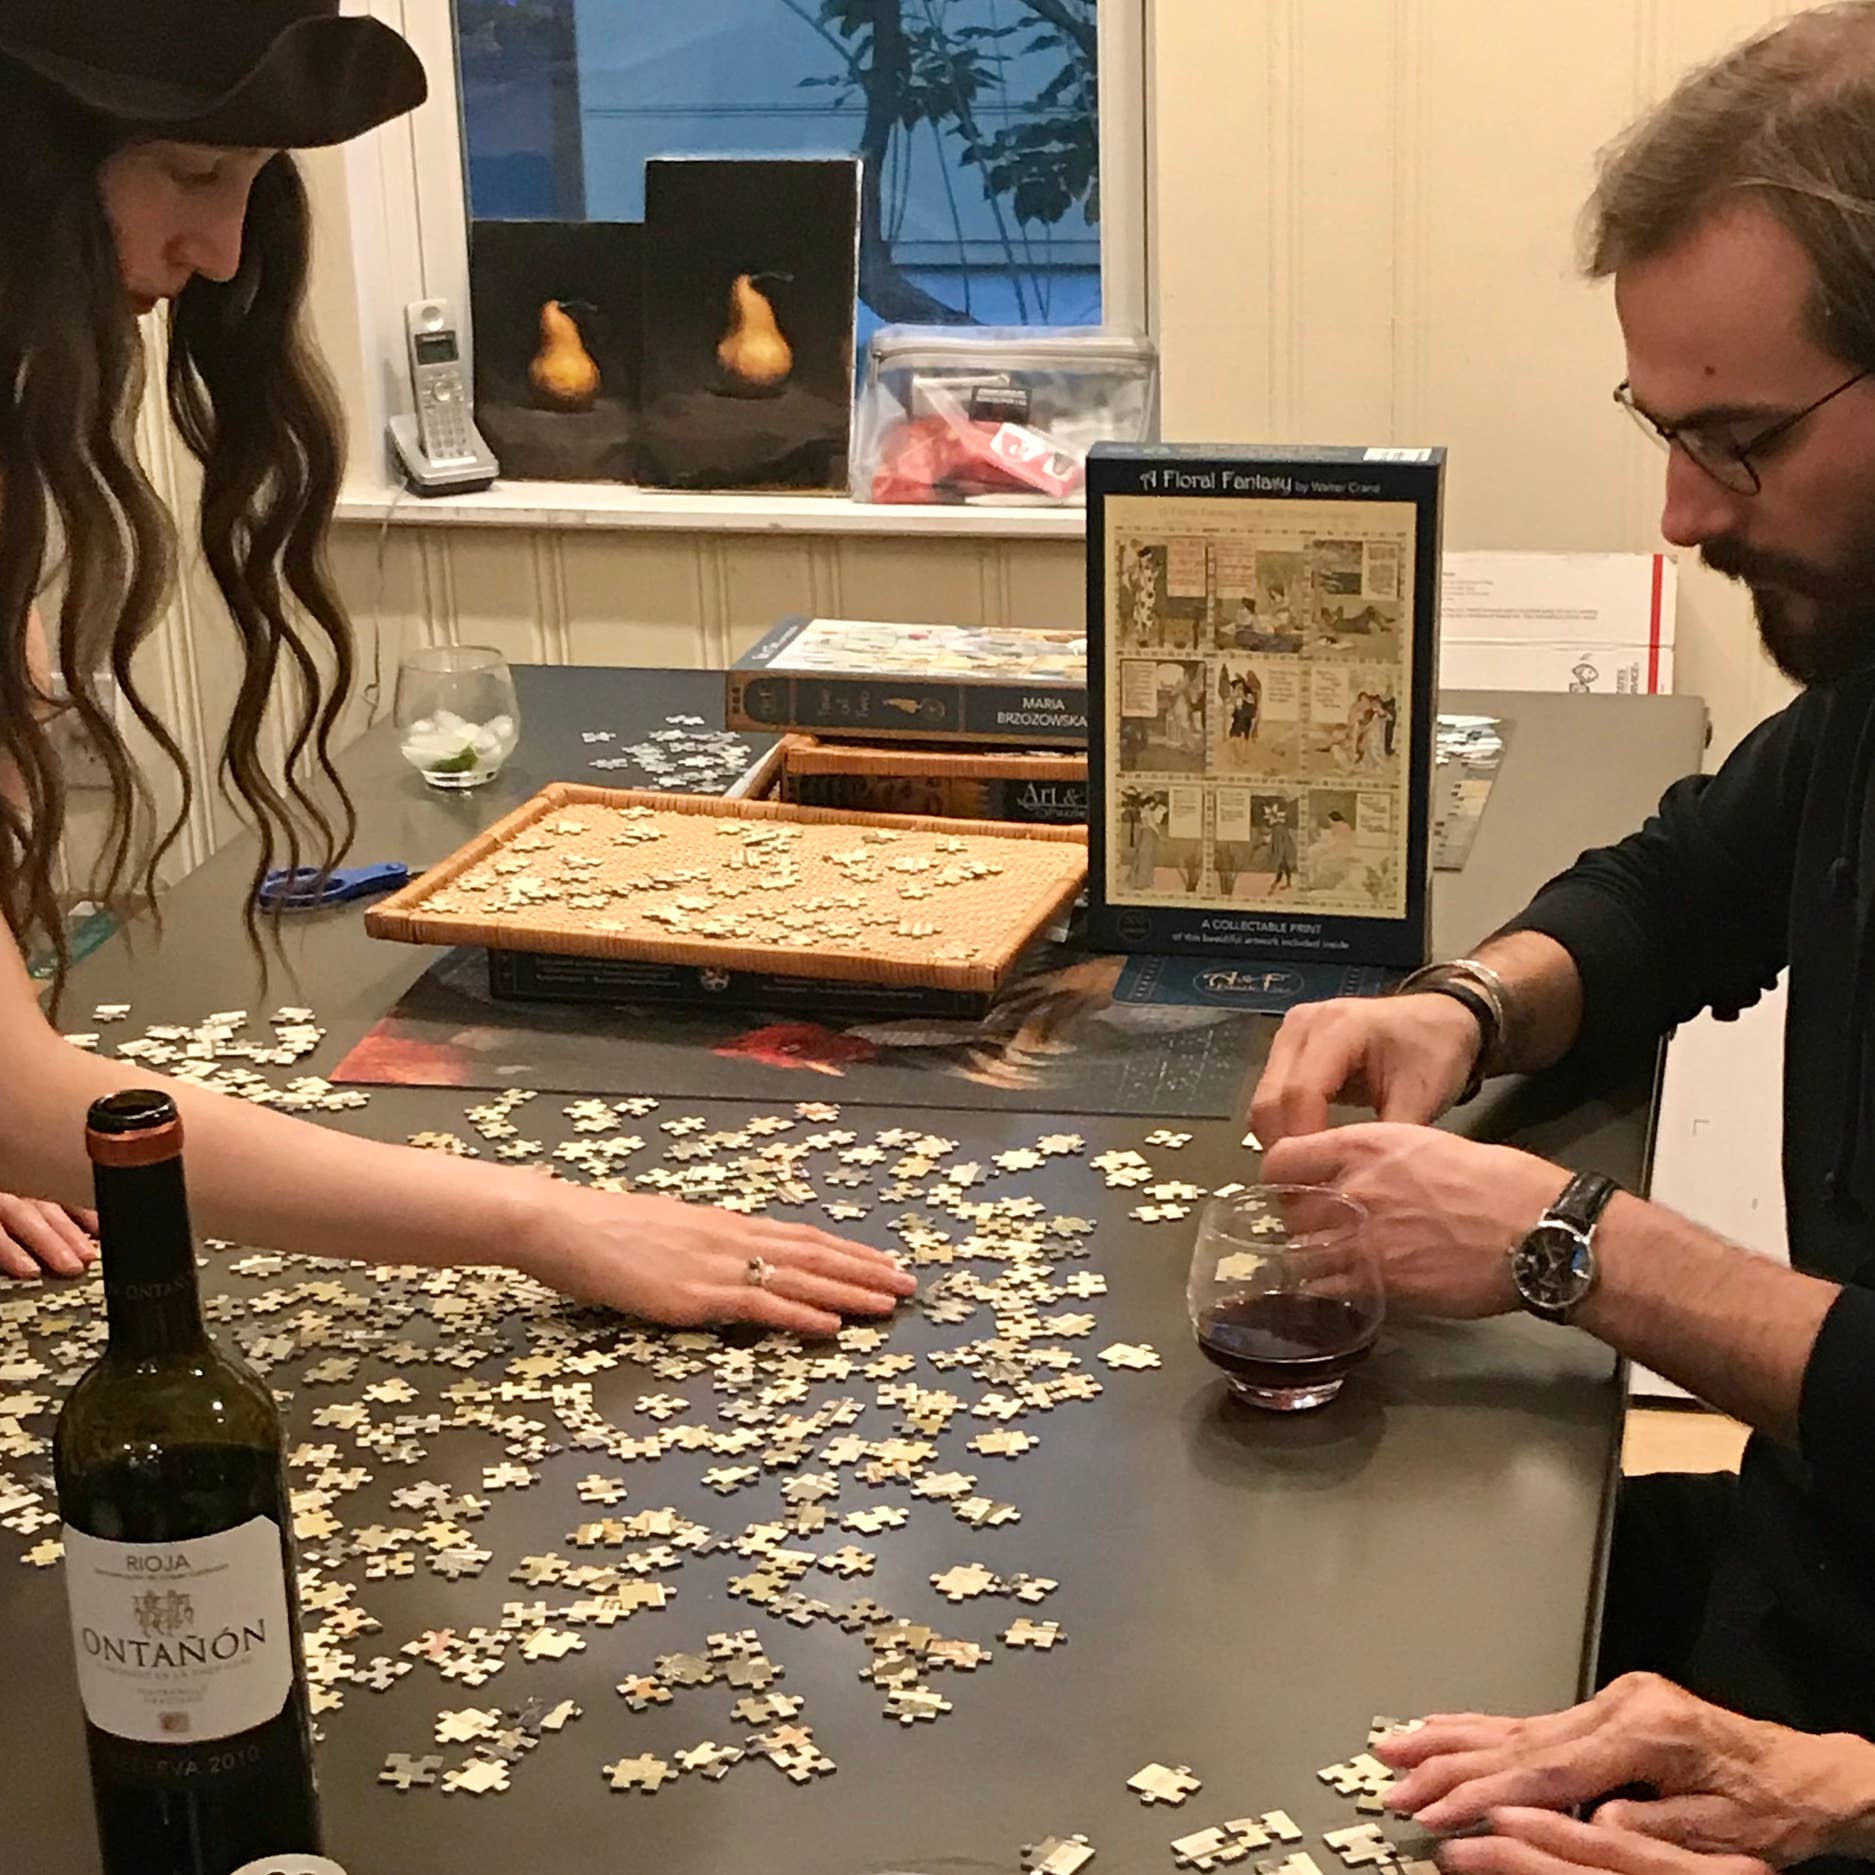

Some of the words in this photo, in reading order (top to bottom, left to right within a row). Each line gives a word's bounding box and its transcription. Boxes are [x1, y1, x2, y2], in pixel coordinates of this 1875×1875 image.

[1163, 470, 1215, 490] Floral
[1222, 471, 1293, 496] Fantasy
[1022, 697, 1066, 711] MARIA
[996, 711, 1088, 728] BRZOZOWSKA
[1202, 919, 1210, 928] A
[1212, 919, 1287, 933] COLLECTABLE
[1289, 923, 1323, 934] PRINT
[126, 1553, 191, 1573] RIOJA
[83, 1618, 267, 1669] ONTAÑÓN
